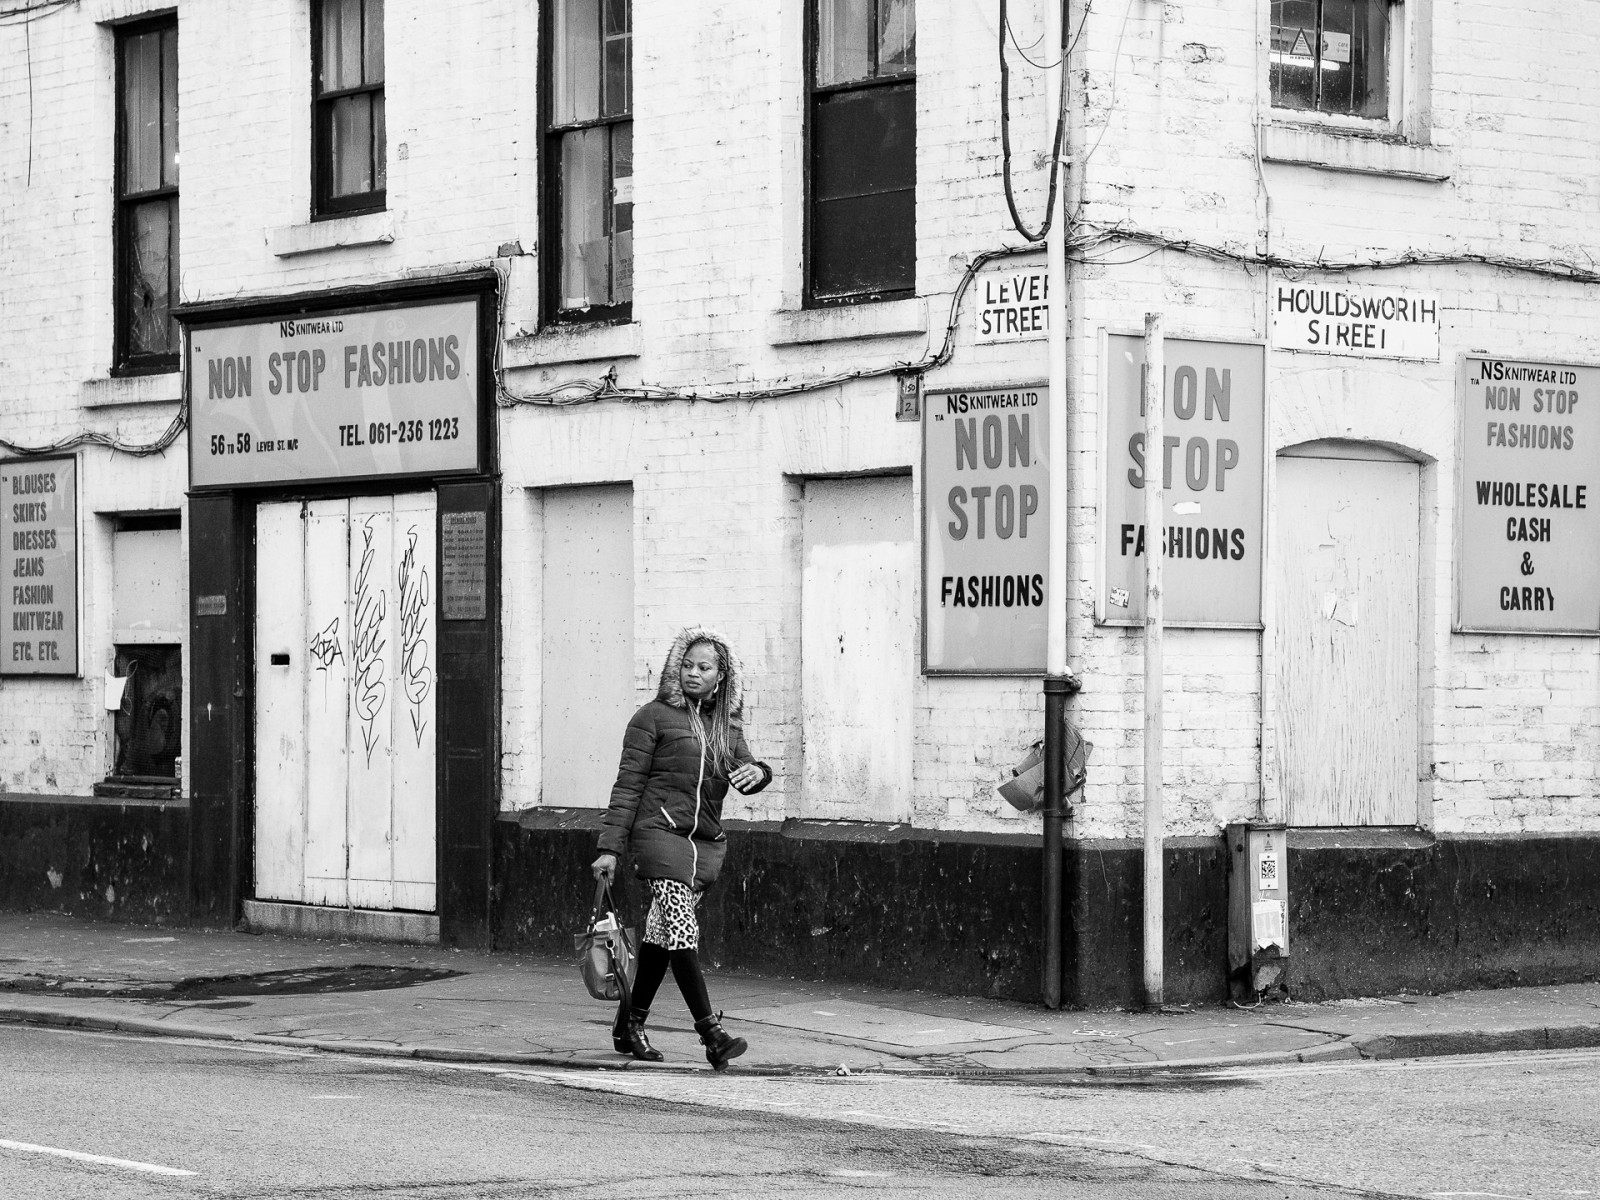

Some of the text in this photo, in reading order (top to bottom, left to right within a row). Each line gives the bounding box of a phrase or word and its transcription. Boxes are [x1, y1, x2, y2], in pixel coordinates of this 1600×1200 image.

[280, 320, 344, 338] NS KNITWEAR LTD
[208, 334, 461, 400] NON STOP FASHIONS
[1481, 361, 1577, 385] NS KNITWEAR LTD
[905, 403, 913, 412] 2
[947, 392, 1038, 414] NS KNITWEAR LTD
[1485, 386, 1579, 414] NON STOP
[339, 417, 459, 447] TEL. 061-236 1223
[954, 413, 1031, 471] NON
[1487, 422, 1574, 451] FASHIONS
[211, 435, 225, 456] 56
[227, 443, 234, 454] TO
[236, 433, 251, 454] 58
[256, 440, 274, 453] LEVER
[276, 440, 286, 452] ST.
[13, 472, 56, 495] BLOUSES
[1476, 481, 1587, 509] WHOLESALE
[13, 502, 47, 523] SKIRTS
[948, 484, 1039, 541] STOP
[13, 529, 56, 551] DRESSES
[1506, 516, 1551, 542] CASH
[13, 557, 44, 578] JEANS
[1520, 551, 1535, 576] &
[13, 585, 54, 606] FASHION
[941, 573, 1044, 608] FASHIONS
[13, 611, 64, 631] KNITWEAR
[12, 640, 60, 662] ETC. ETC.
